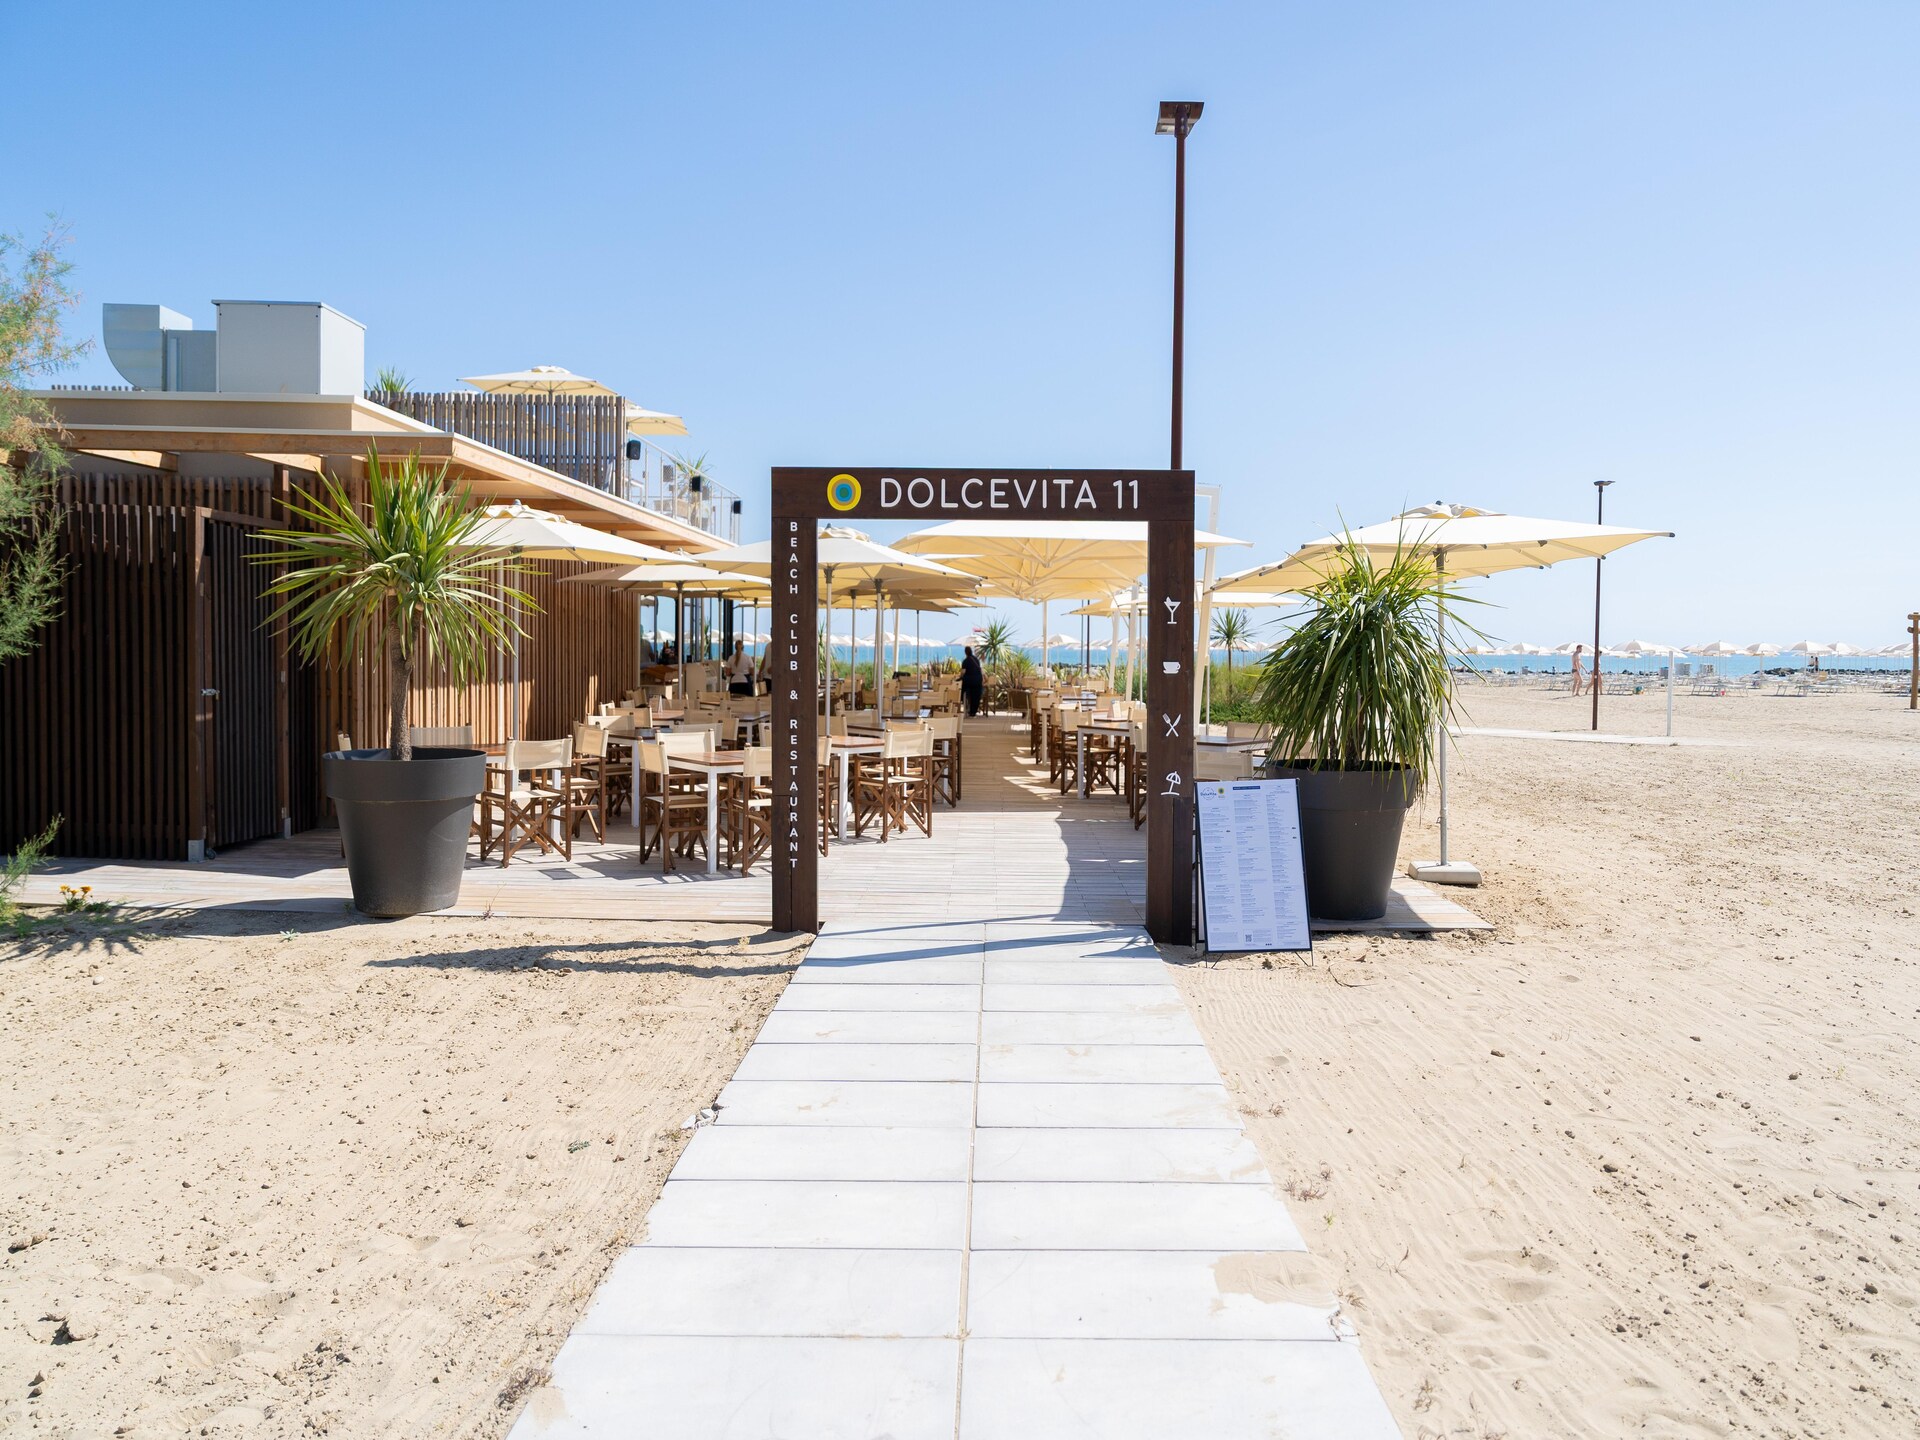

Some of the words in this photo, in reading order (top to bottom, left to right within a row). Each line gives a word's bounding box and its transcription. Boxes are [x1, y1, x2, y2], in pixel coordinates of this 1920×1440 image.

[880, 477, 1097, 510] DOLCEVITA
[1112, 479, 1139, 510] 11
[789, 521, 798, 595] BEACH
[789, 613, 798, 671] CLUB
[789, 689, 799, 700] &
[789, 719, 799, 869] RESTAURANT
